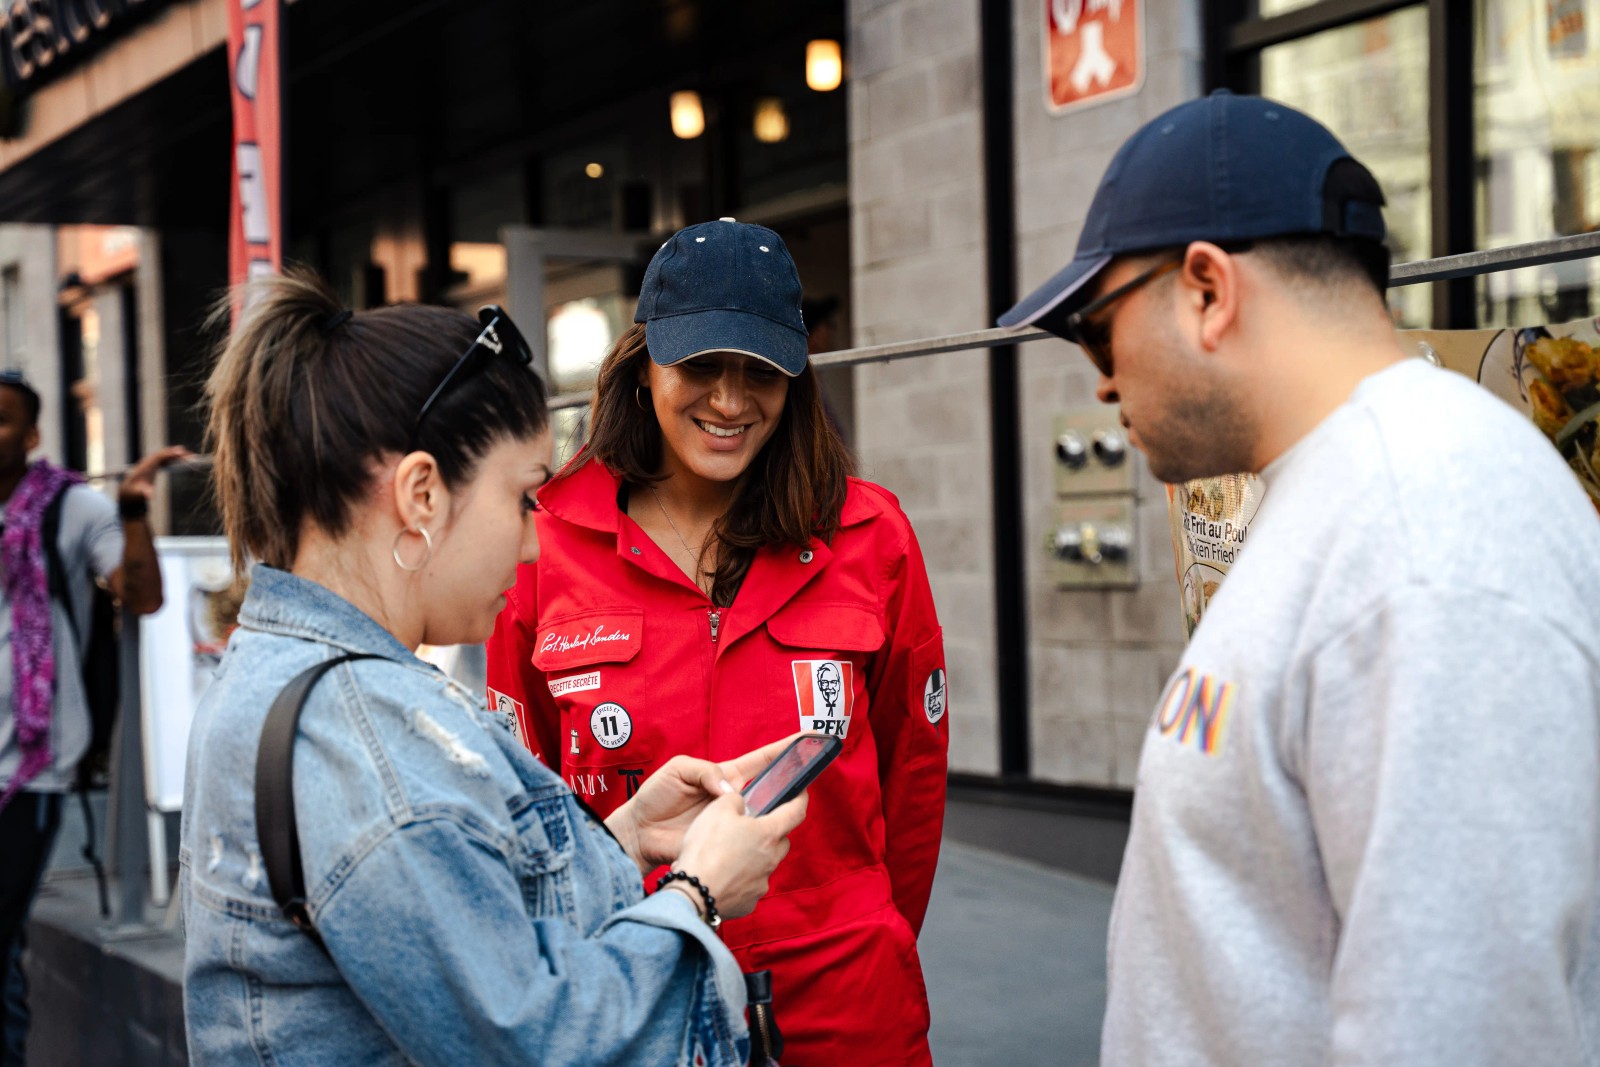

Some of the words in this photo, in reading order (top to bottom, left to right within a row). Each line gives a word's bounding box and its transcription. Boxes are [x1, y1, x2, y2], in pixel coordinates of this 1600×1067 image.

[1191, 515, 1207, 536] Frit
[1208, 523, 1222, 539] au
[1211, 543, 1235, 564] Fried
[589, 625, 630, 646] Sanders
[549, 679, 572, 694] RECETTE
[572, 675, 599, 689] SECRÈTE
[600, 715, 619, 737] 11
[813, 719, 845, 735] PFK
